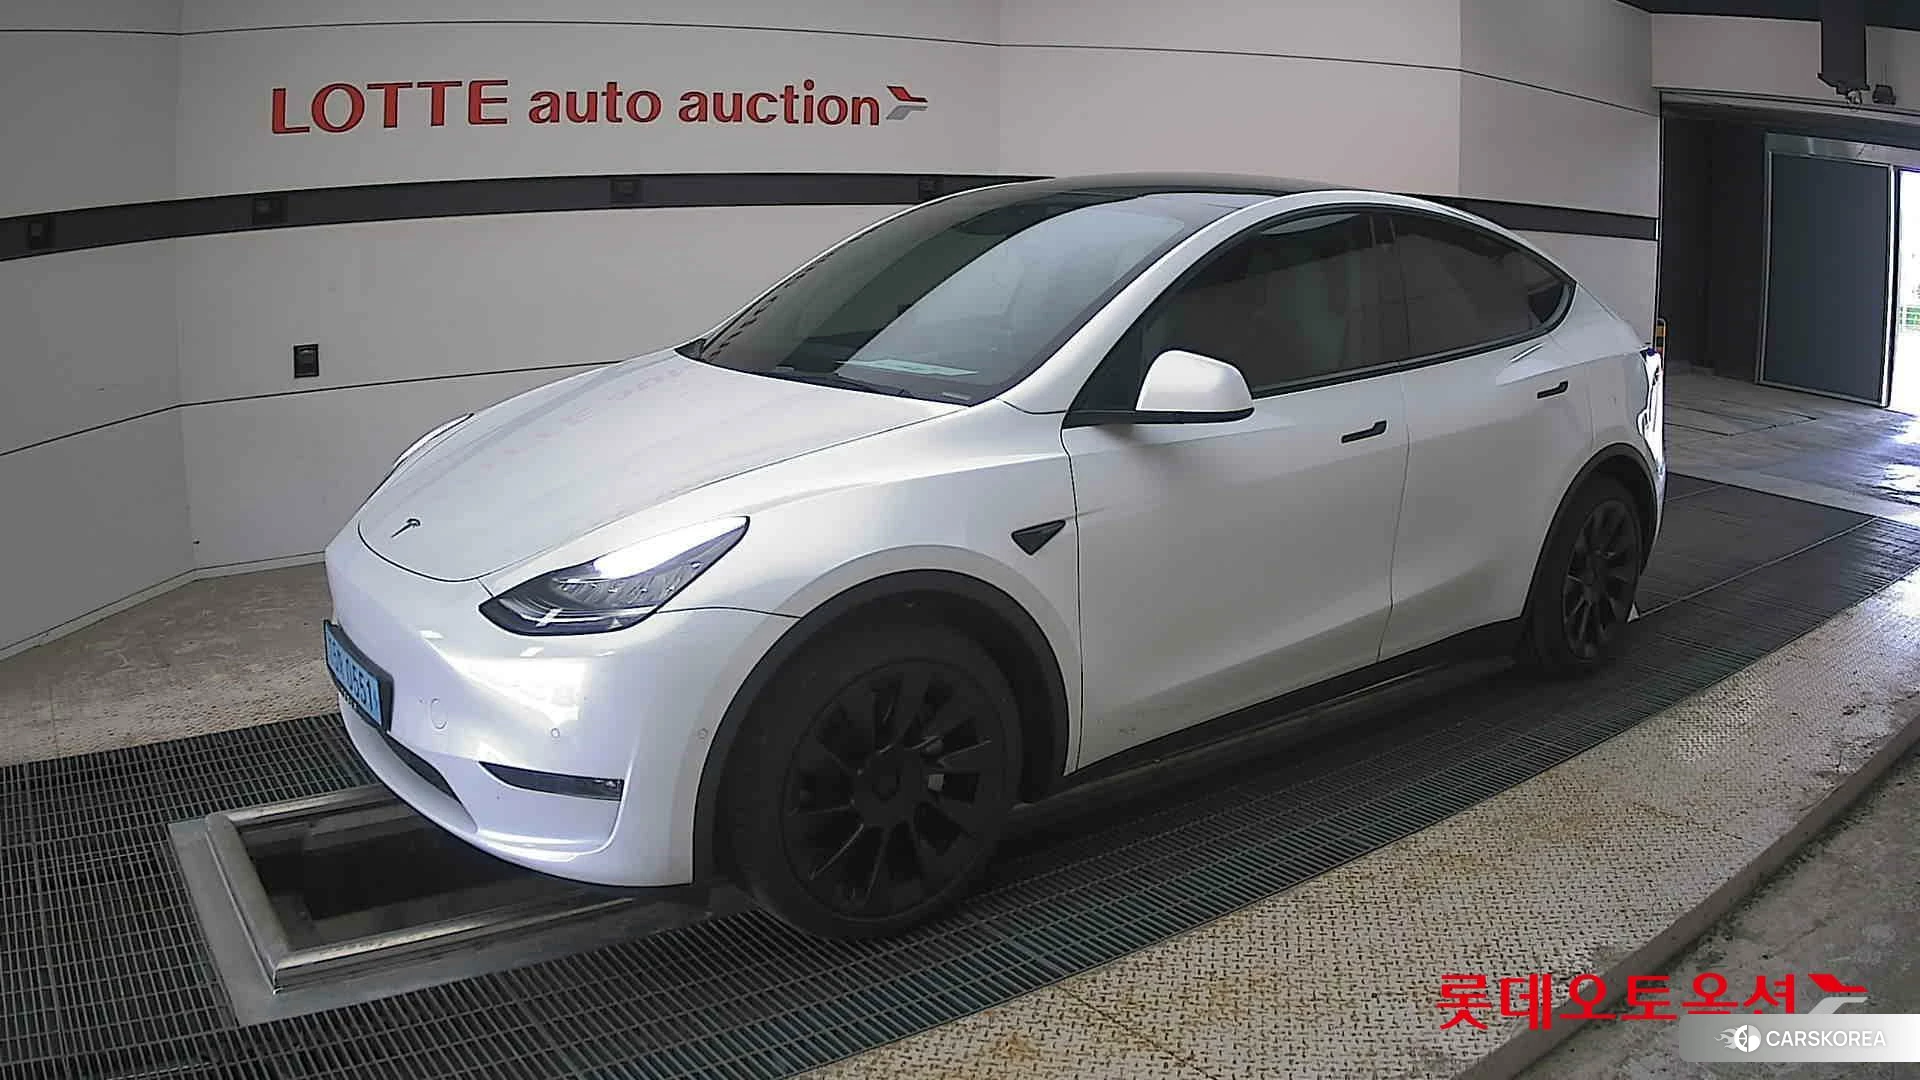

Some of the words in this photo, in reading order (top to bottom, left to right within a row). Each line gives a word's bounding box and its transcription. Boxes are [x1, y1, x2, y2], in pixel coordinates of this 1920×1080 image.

[270, 79, 509, 135] LOTTE
[528, 81, 662, 124] auto
[678, 80, 880, 126] auction
